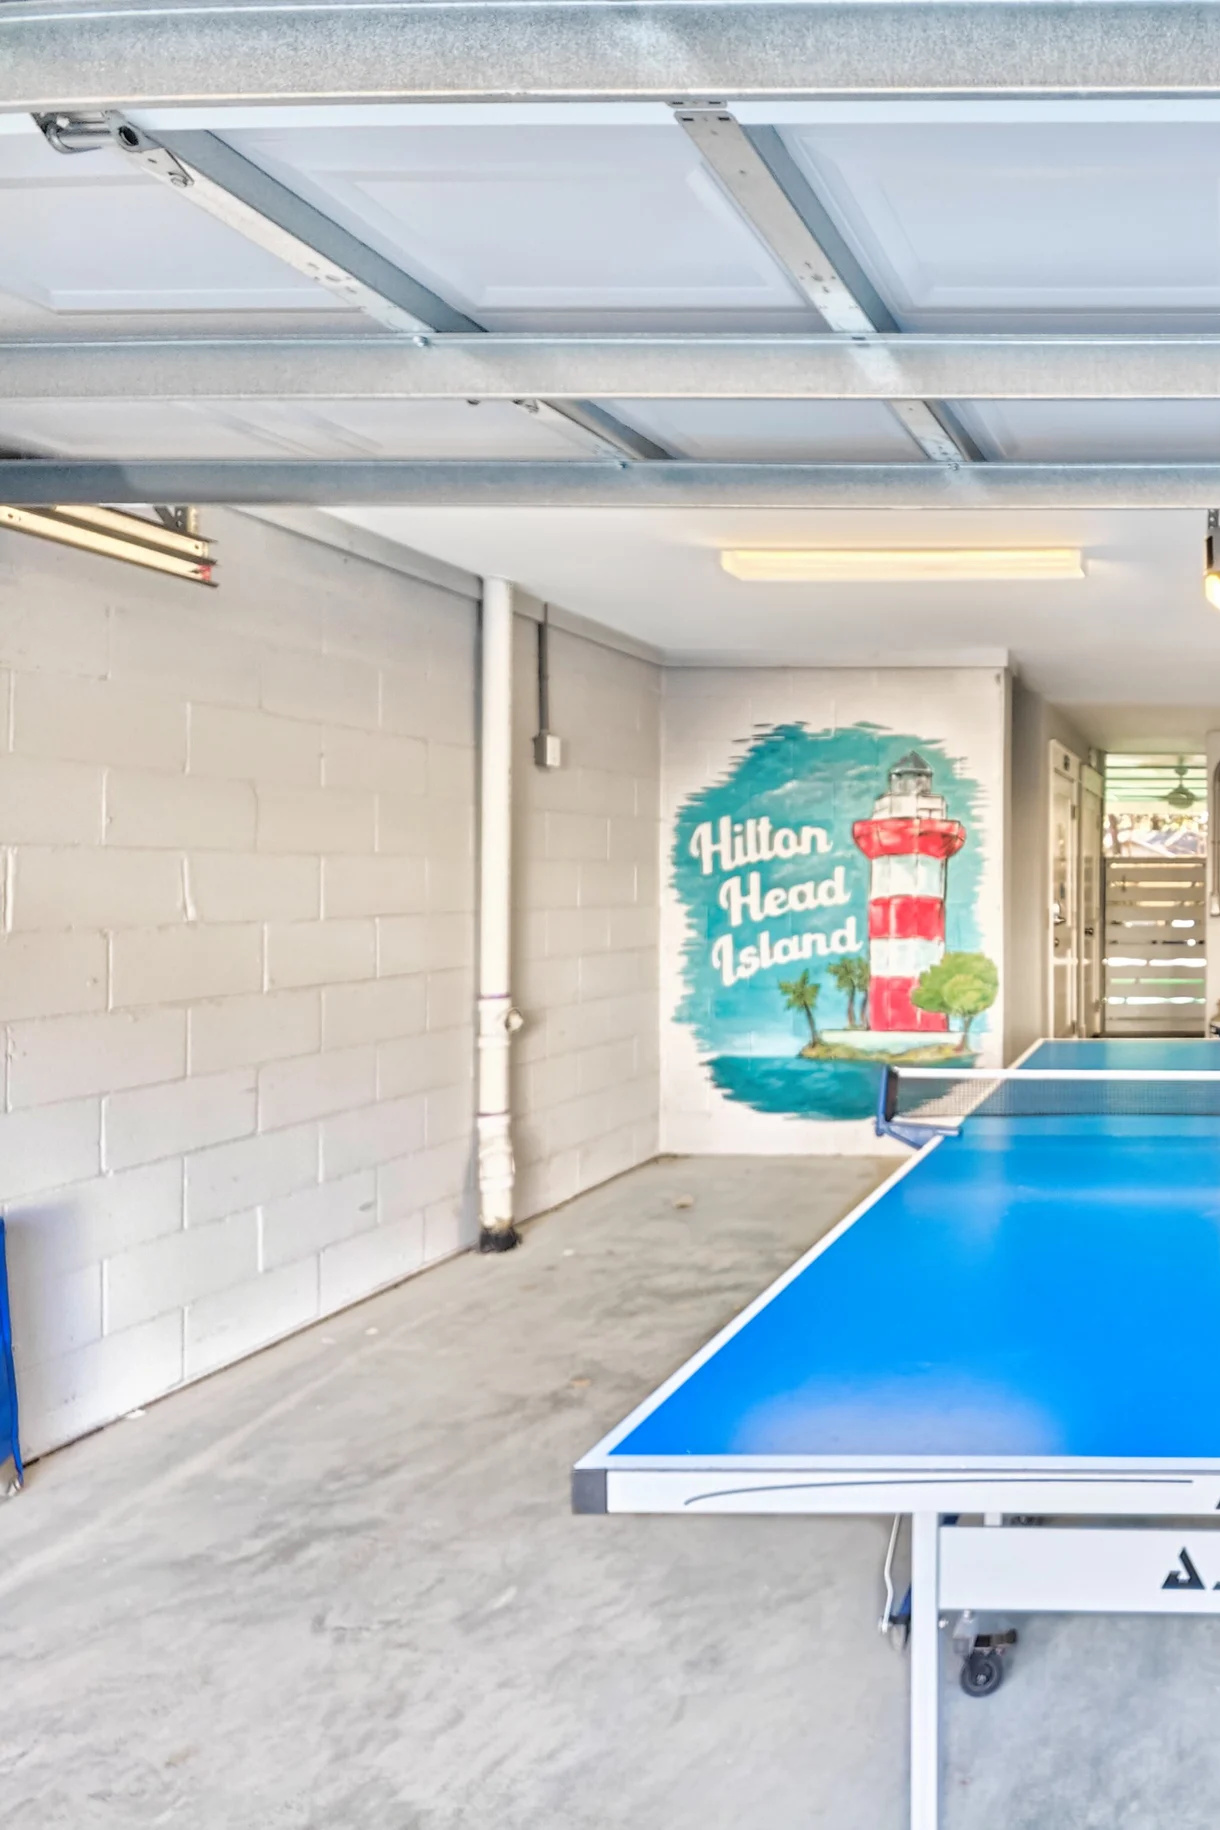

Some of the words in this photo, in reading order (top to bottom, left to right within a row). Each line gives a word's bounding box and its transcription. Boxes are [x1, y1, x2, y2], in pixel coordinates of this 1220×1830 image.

[689, 815, 833, 875] Hilton
[719, 866, 851, 927] Head
[711, 916, 864, 986] Island
